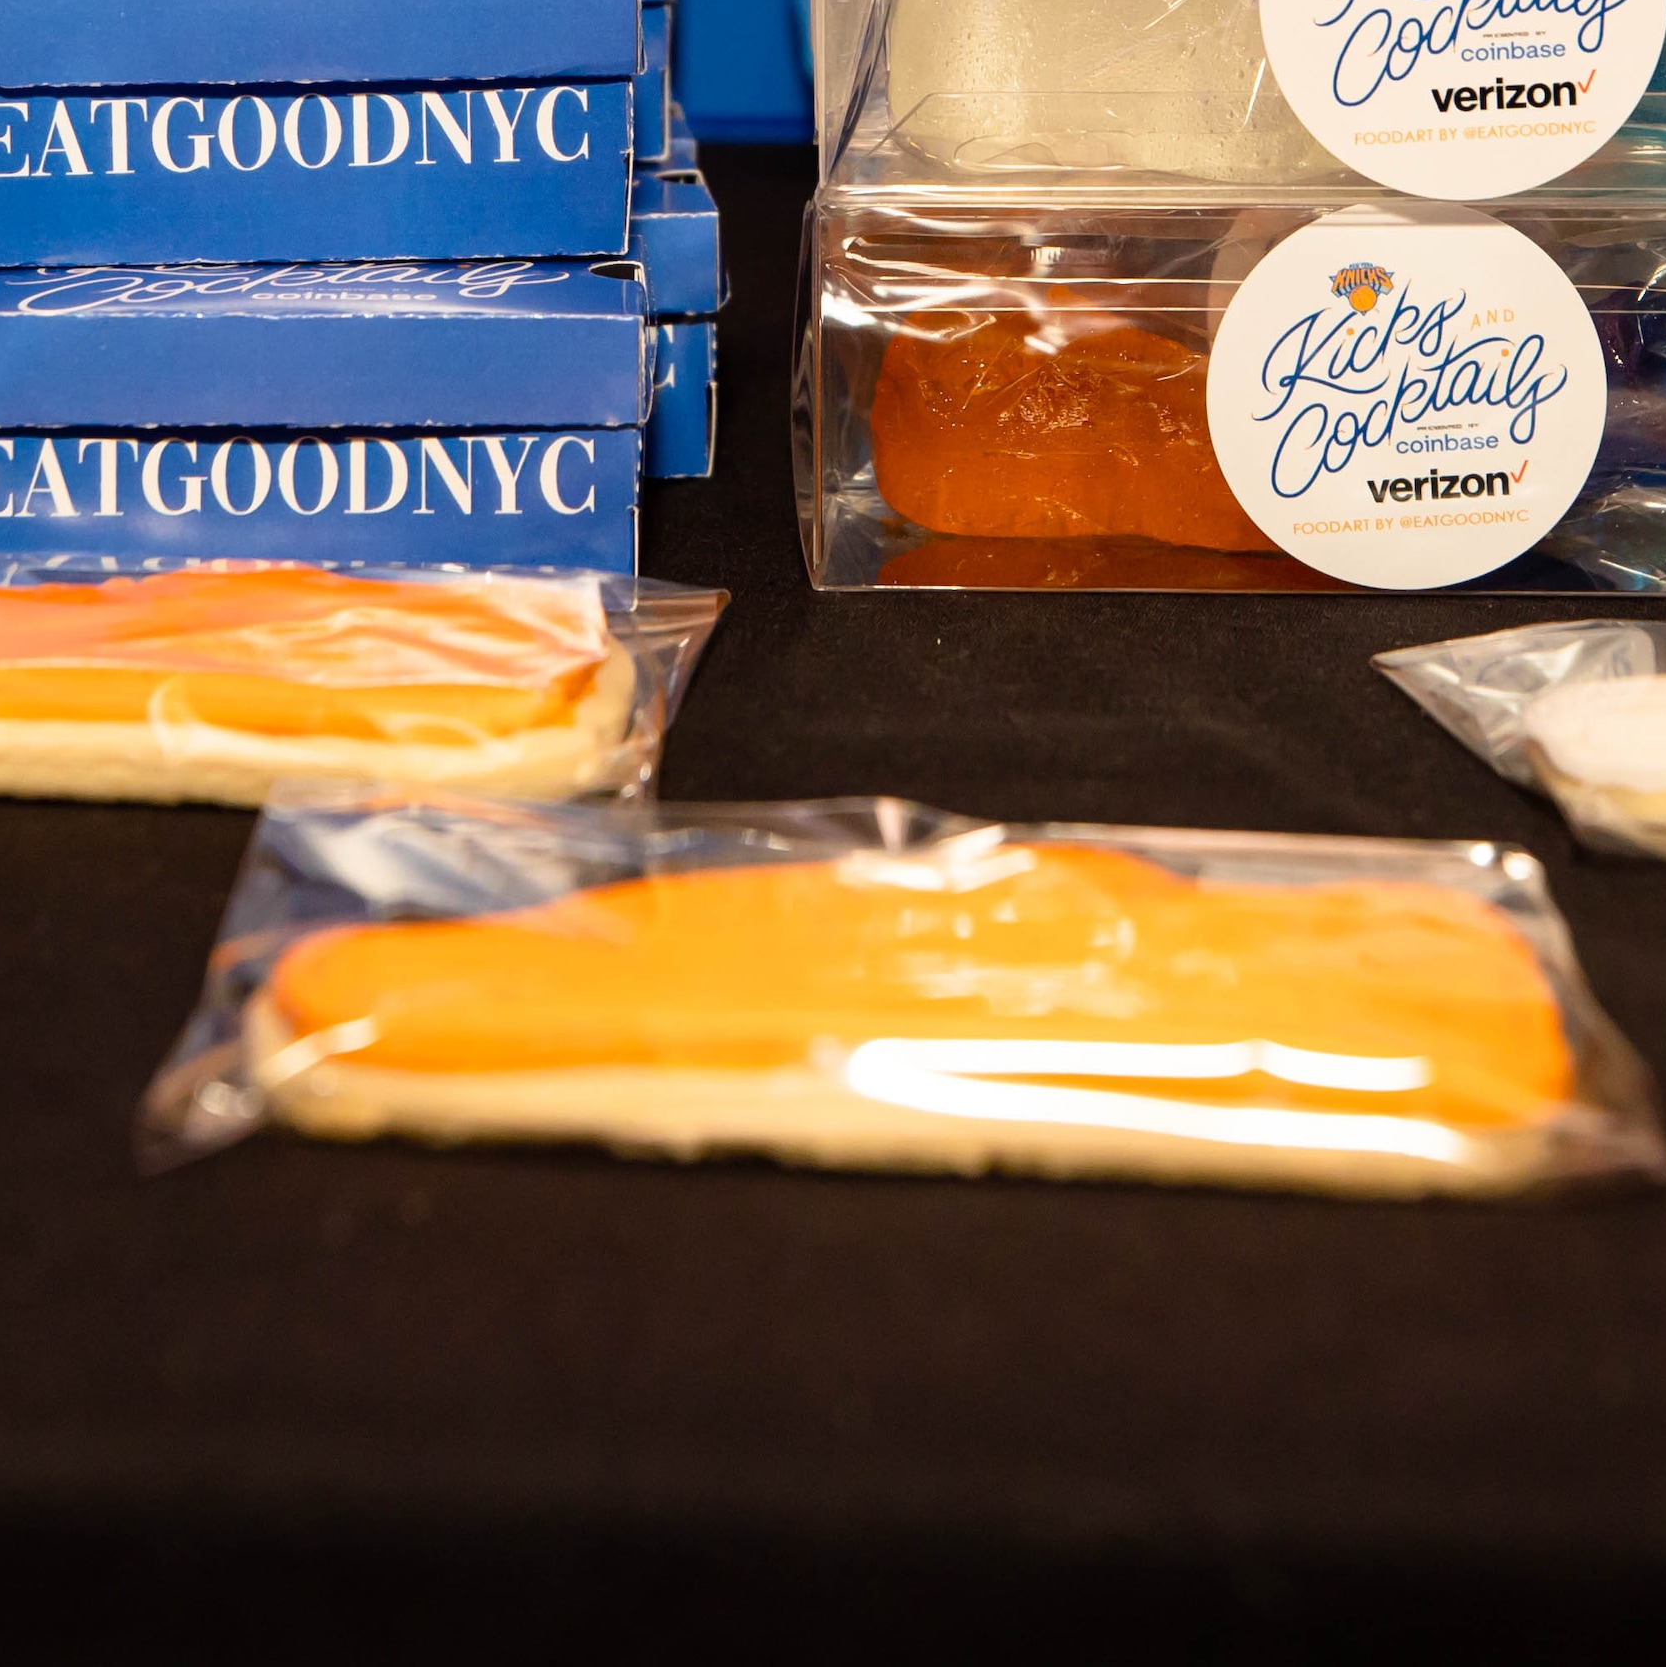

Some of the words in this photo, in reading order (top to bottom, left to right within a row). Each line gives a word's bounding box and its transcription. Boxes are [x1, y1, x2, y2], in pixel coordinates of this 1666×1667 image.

[1461, 41, 1566, 62] coinbase
[1431, 77, 1577, 113] verizon
[1354, 128, 1433, 146] FOODART
[1439, 127, 1459, 142] BY
[1463, 119, 1597, 141] @EATGOODNYC
[17, 260, 570, 314] Cocktails
[252, 291, 437, 301] coinbase
[1331, 266, 1395, 298] KNICKS
[1251, 278, 1466, 421] Kicks
[1470, 308, 1515, 332] AND
[1271, 334, 1568, 498] Cocktails
[1396, 433, 1499, 454] coinbase
[1367, 468, 1510, 503] verizon
[1293, 517, 1372, 535] FOODART
[1376, 517, 1394, 531] BY
[1399, 509, 1531, 529] @EATGOODNYC
